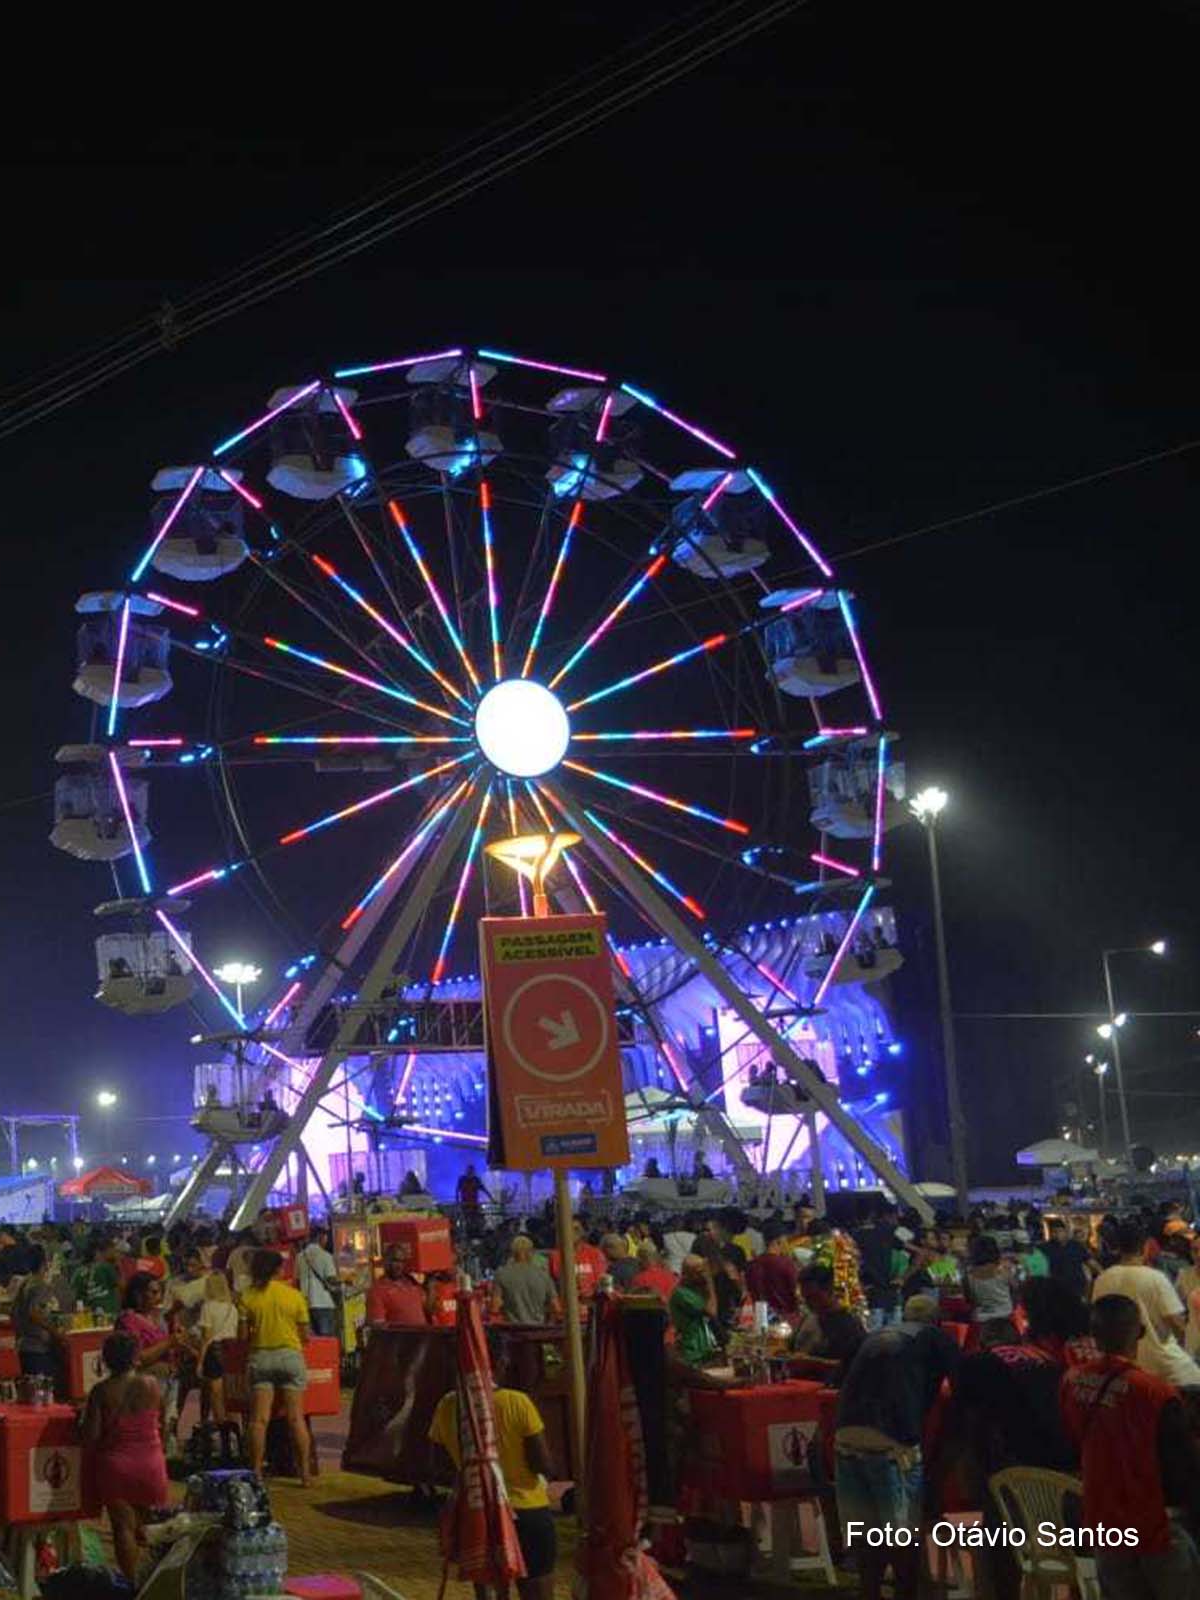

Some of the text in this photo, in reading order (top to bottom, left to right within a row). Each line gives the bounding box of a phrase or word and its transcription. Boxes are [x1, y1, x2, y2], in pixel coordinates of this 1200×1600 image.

[500, 931, 594, 947] PASSAGEM
[502, 944, 597, 960] ACESSÍVEL
[523, 1101, 606, 1119] VIRADA
